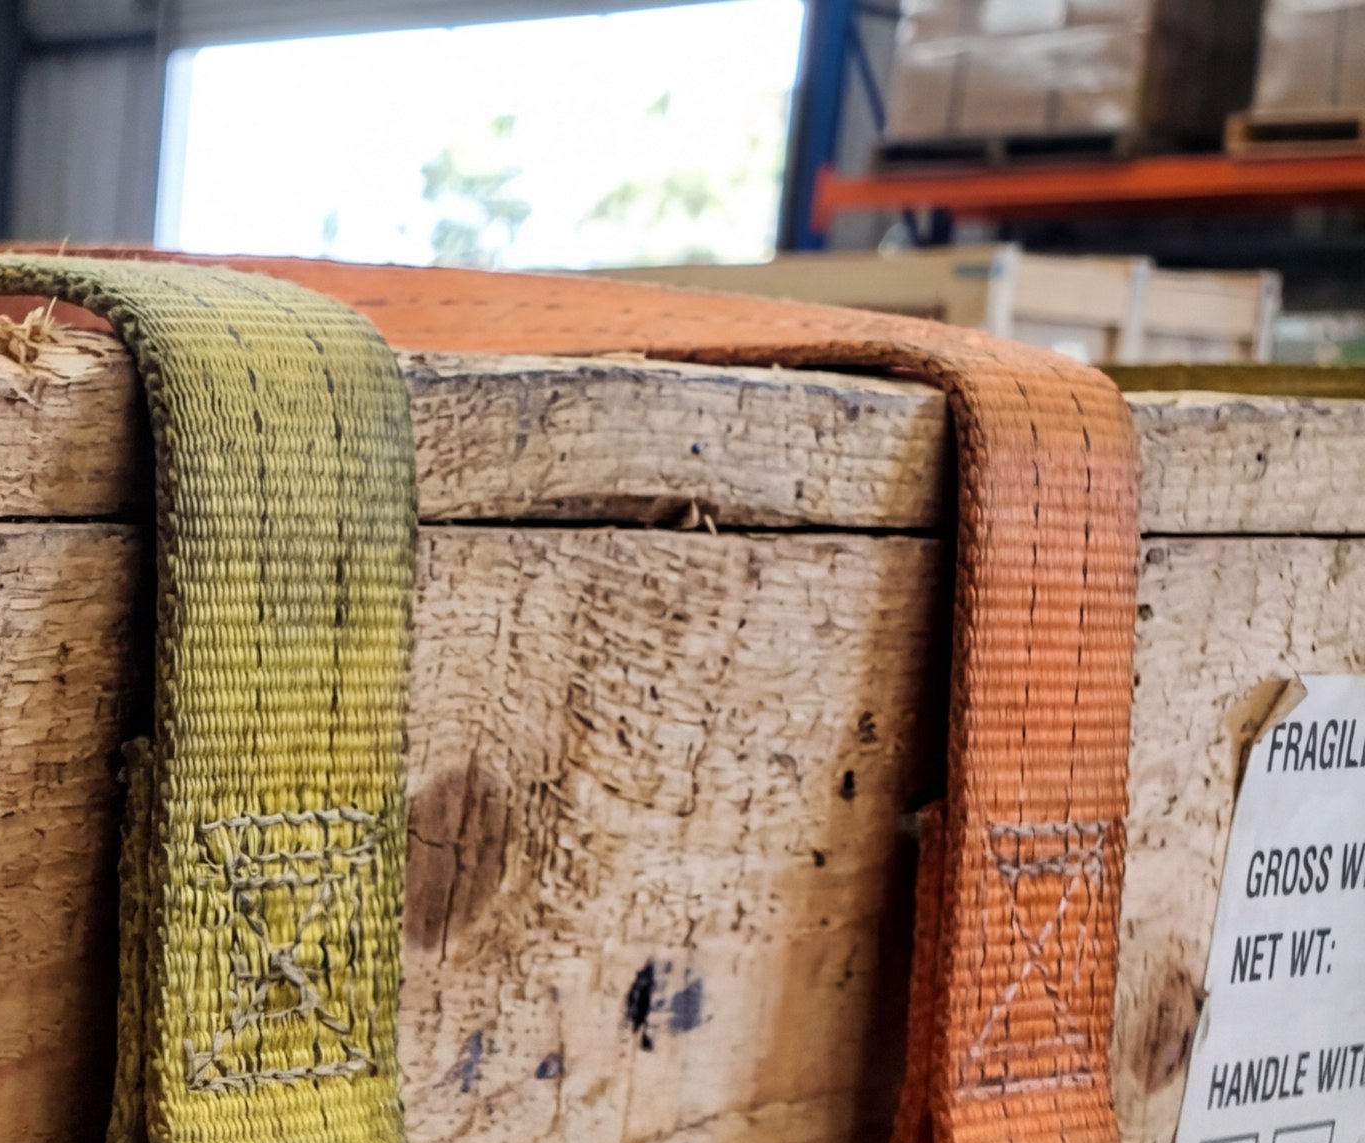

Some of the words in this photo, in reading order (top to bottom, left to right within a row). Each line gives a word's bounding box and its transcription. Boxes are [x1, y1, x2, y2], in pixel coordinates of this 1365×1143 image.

[1267, 718, 1365, 773] FRAGIL
[1245, 843, 1333, 899] GROSS
[1341, 842, 1365, 890] W
[1230, 932, 1284, 984] NET
[1290, 927, 1335, 977] WT:
[1207, 1051, 1310, 1110] HANDLE
